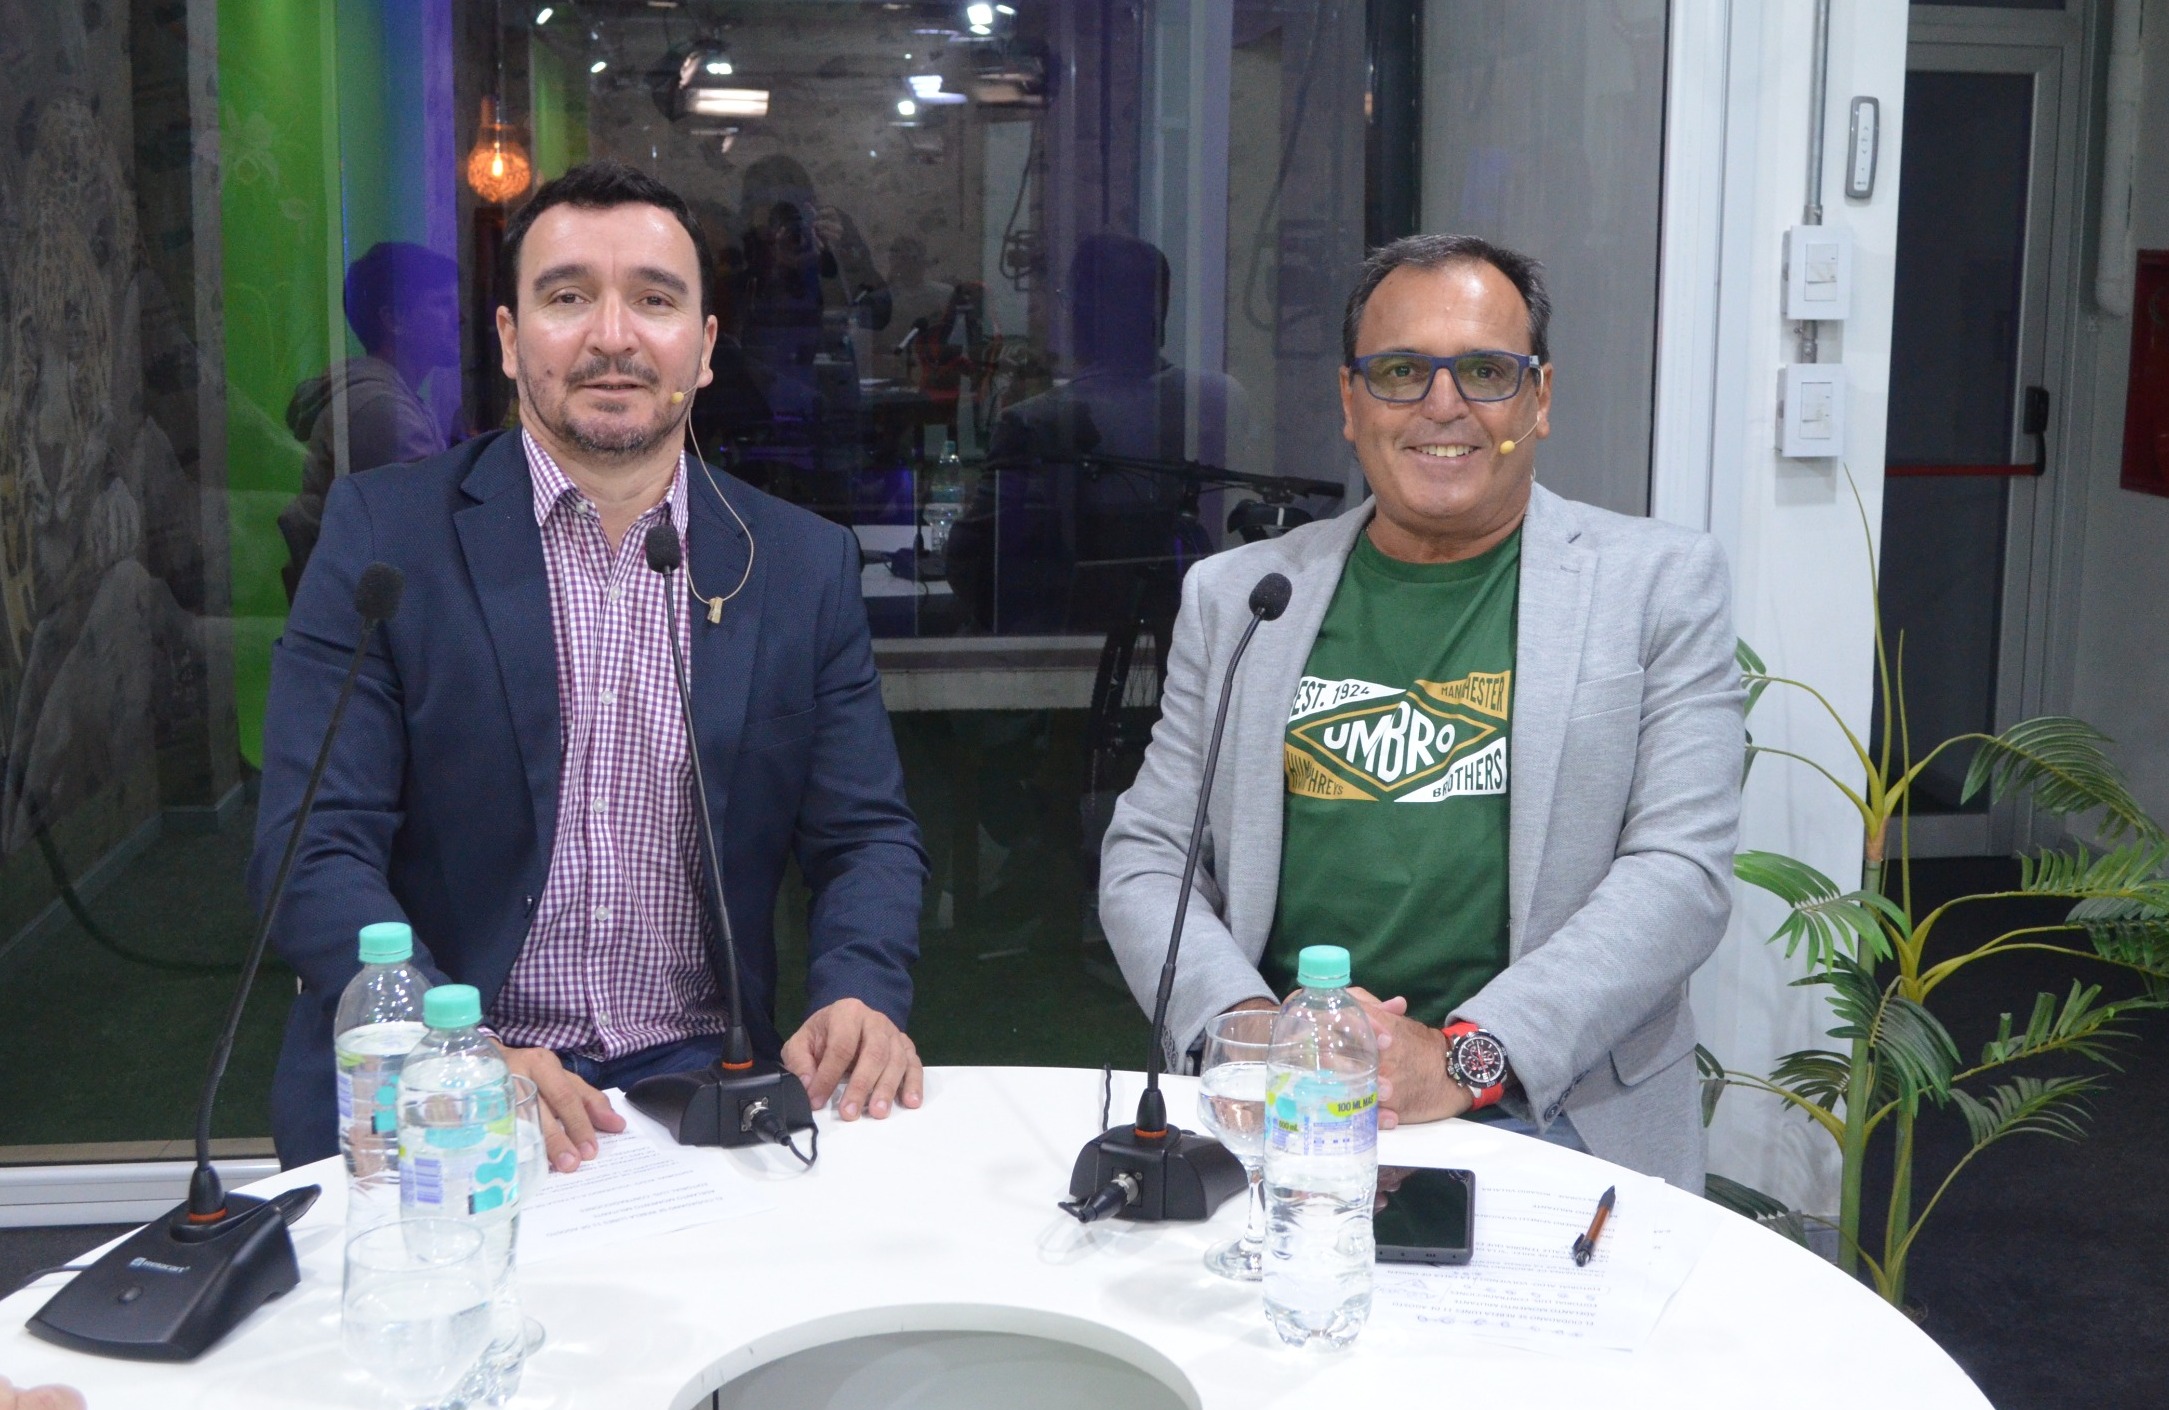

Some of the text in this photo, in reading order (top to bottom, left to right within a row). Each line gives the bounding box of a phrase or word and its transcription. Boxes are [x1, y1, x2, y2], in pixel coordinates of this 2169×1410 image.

[1292, 680, 1370, 713] EST. 1924
[1441, 676, 1504, 712] MANHESTER
[1323, 700, 1456, 783] UMBRO
[1433, 748, 1503, 797] BROTHERS
[1337, 1102, 1351, 1112] 100
[1352, 1100, 1361, 1109] ML
